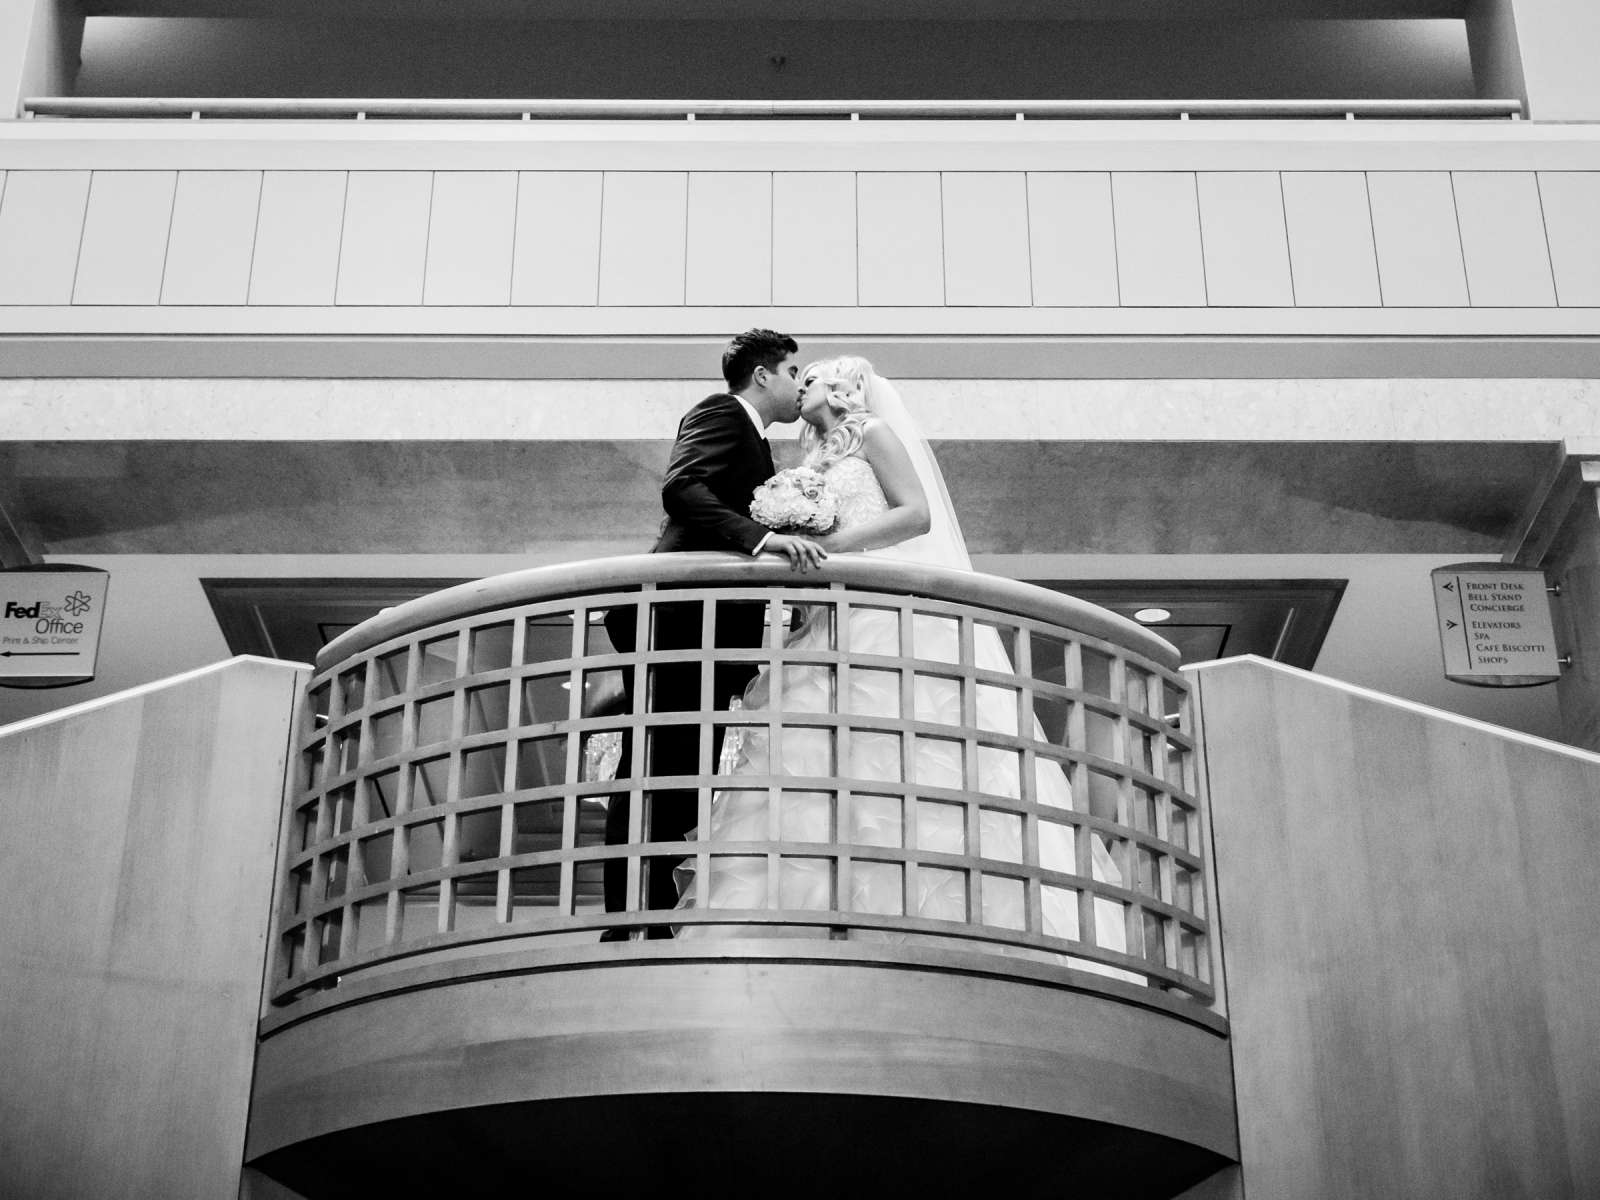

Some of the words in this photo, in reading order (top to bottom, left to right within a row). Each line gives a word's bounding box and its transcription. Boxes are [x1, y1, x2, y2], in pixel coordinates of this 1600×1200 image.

[1466, 582, 1497, 591] FRONT
[1500, 582, 1525, 591] DESK
[1468, 593, 1489, 601] BELL
[1492, 593, 1522, 601] STAND
[1470, 604, 1525, 612] CONCIERGE
[35, 618, 84, 634] Office
[1472, 621, 1522, 629] ELEVATORS
[1474, 632, 1490, 641] SPA
[1502, 644, 1545, 652] BISCOTTI
[1478, 656, 1509, 664] SHOPS
